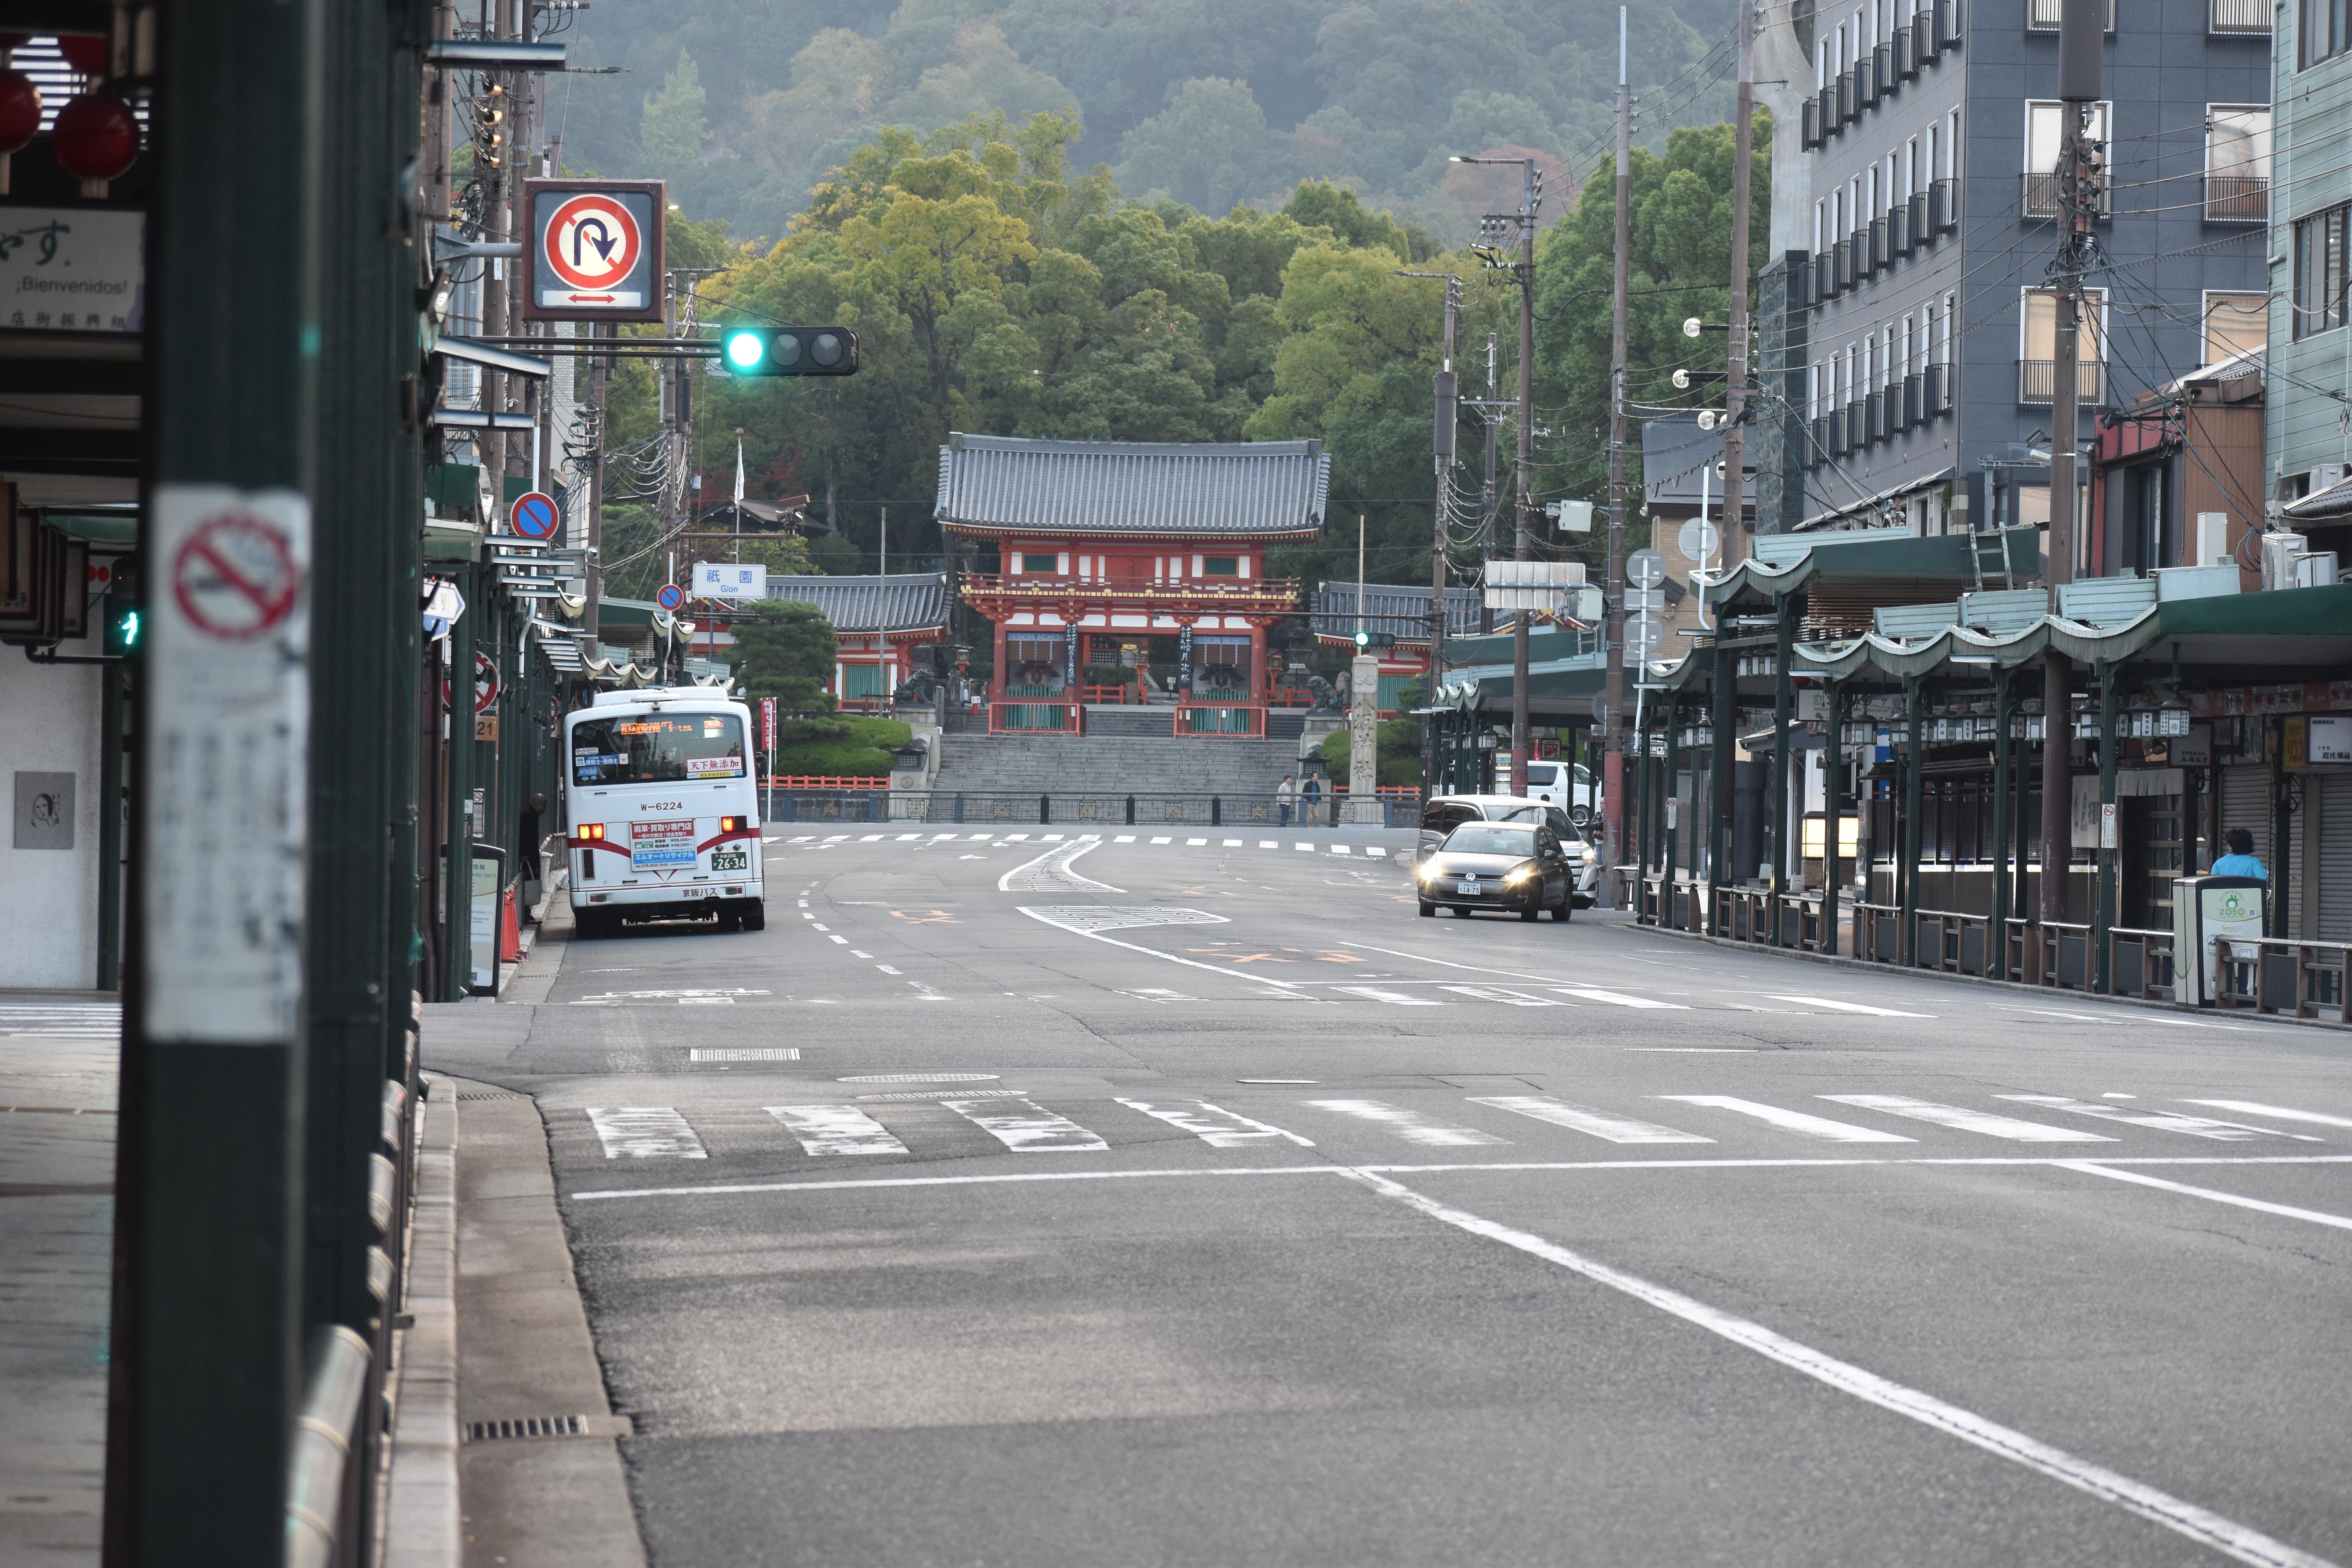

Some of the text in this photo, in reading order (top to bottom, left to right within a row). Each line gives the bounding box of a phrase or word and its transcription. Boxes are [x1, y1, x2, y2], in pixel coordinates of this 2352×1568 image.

[16, 276, 128, 294] ¡Bienvenidos!
[707, 570, 752, 583] 祇園
[1181, 653, 1190, 684] 月次祭
[477, 722, 492, 735] 21
[691, 759, 739, 769] 天下無添加
[641, 802, 682, 811] W-6224
[634, 823, 692, 833] 廃車・買取り専門店
[635, 852, 694, 860] エムオートリサイクル
[718, 857, 745, 869] 26-34
[682, 888, 717, 897] 京阪バス
